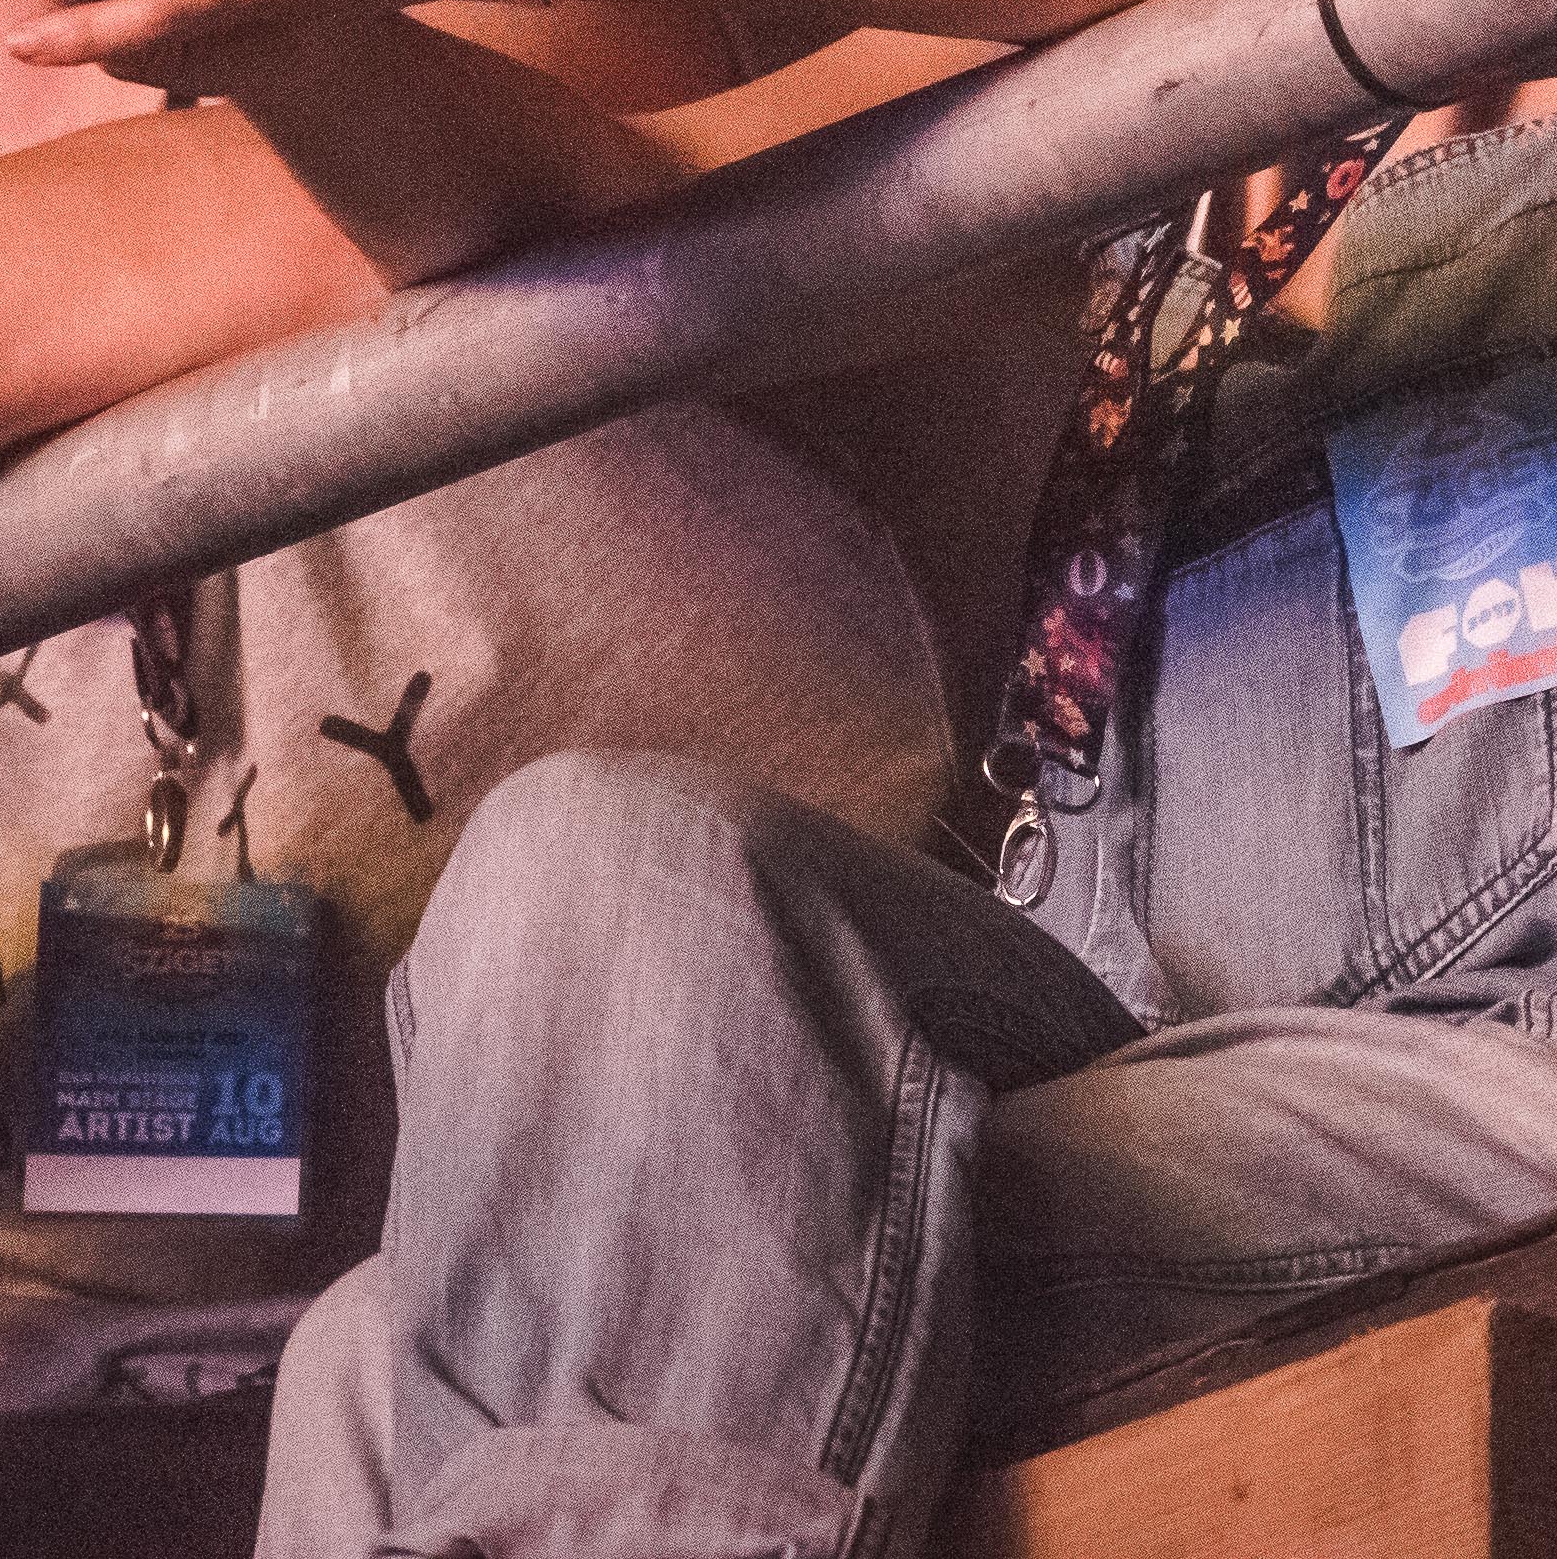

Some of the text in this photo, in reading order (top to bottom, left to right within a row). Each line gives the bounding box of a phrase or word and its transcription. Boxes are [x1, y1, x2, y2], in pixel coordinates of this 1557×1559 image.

[56, 1090, 199, 1109] MAIN STAGE
[210, 1071, 284, 1116] 10
[56, 1111, 198, 1142] ARTIST
[207, 1116, 284, 1145] AUG
